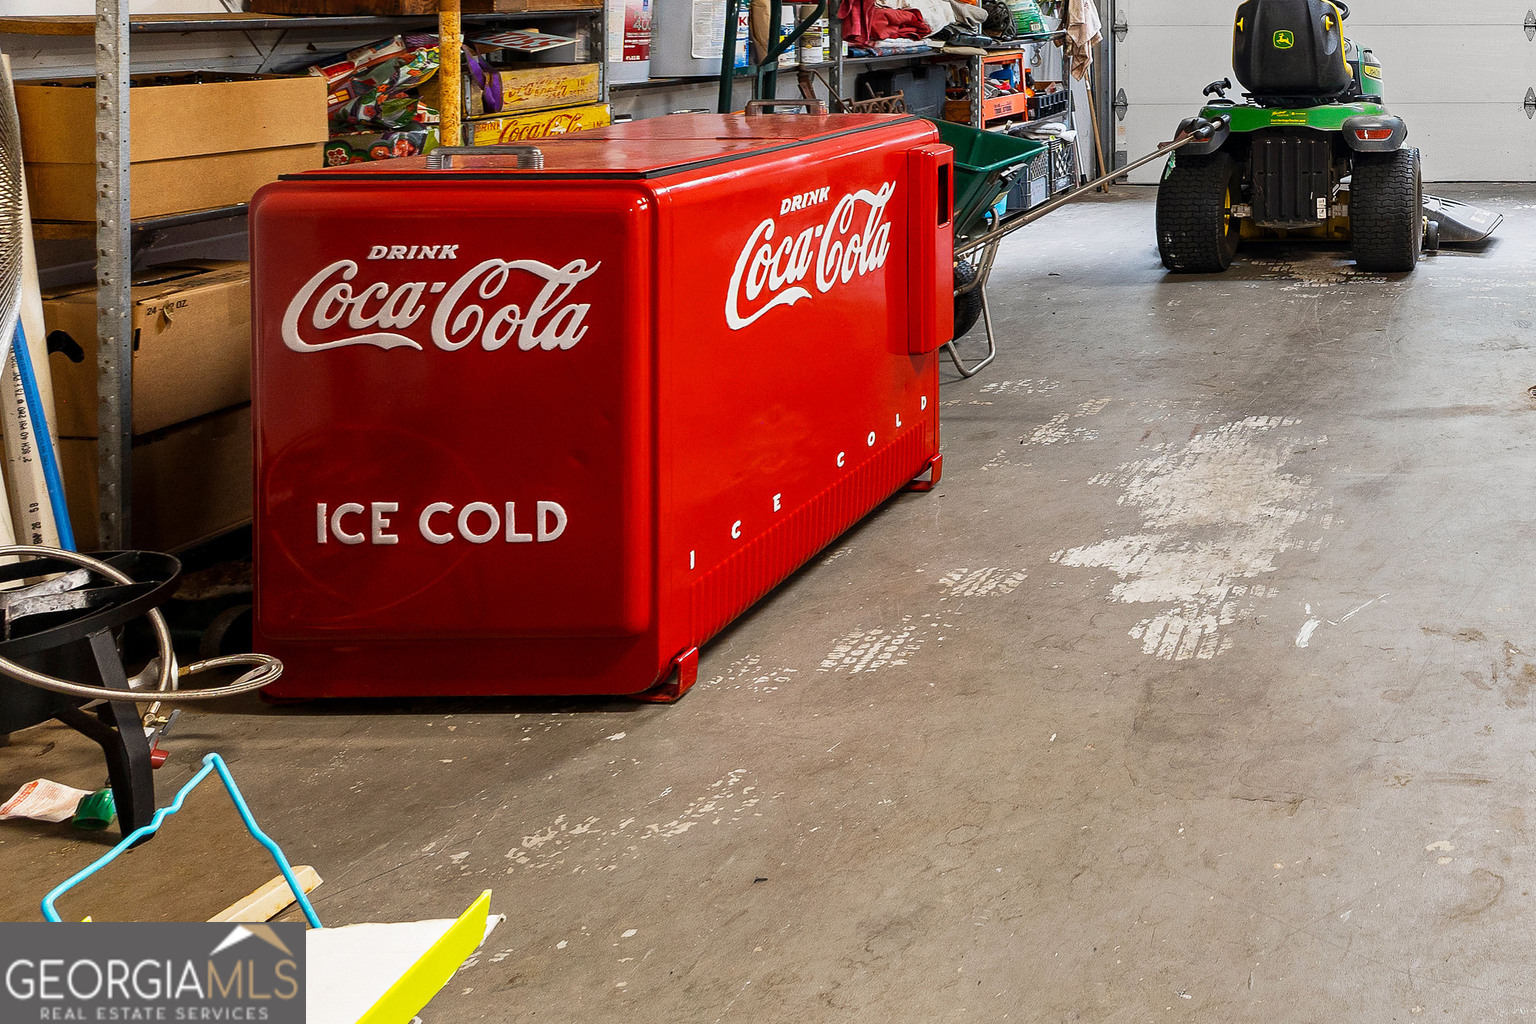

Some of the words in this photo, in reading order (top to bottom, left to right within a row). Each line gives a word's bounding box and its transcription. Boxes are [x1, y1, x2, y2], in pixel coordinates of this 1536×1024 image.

[780, 185, 831, 218] DRINK
[366, 243, 460, 262] DRINK
[725, 180, 897, 332] Coca-Cola
[281, 257, 601, 354] Coca-Cola
[316, 501, 400, 546] ICE
[418, 500, 568, 545] COLD
